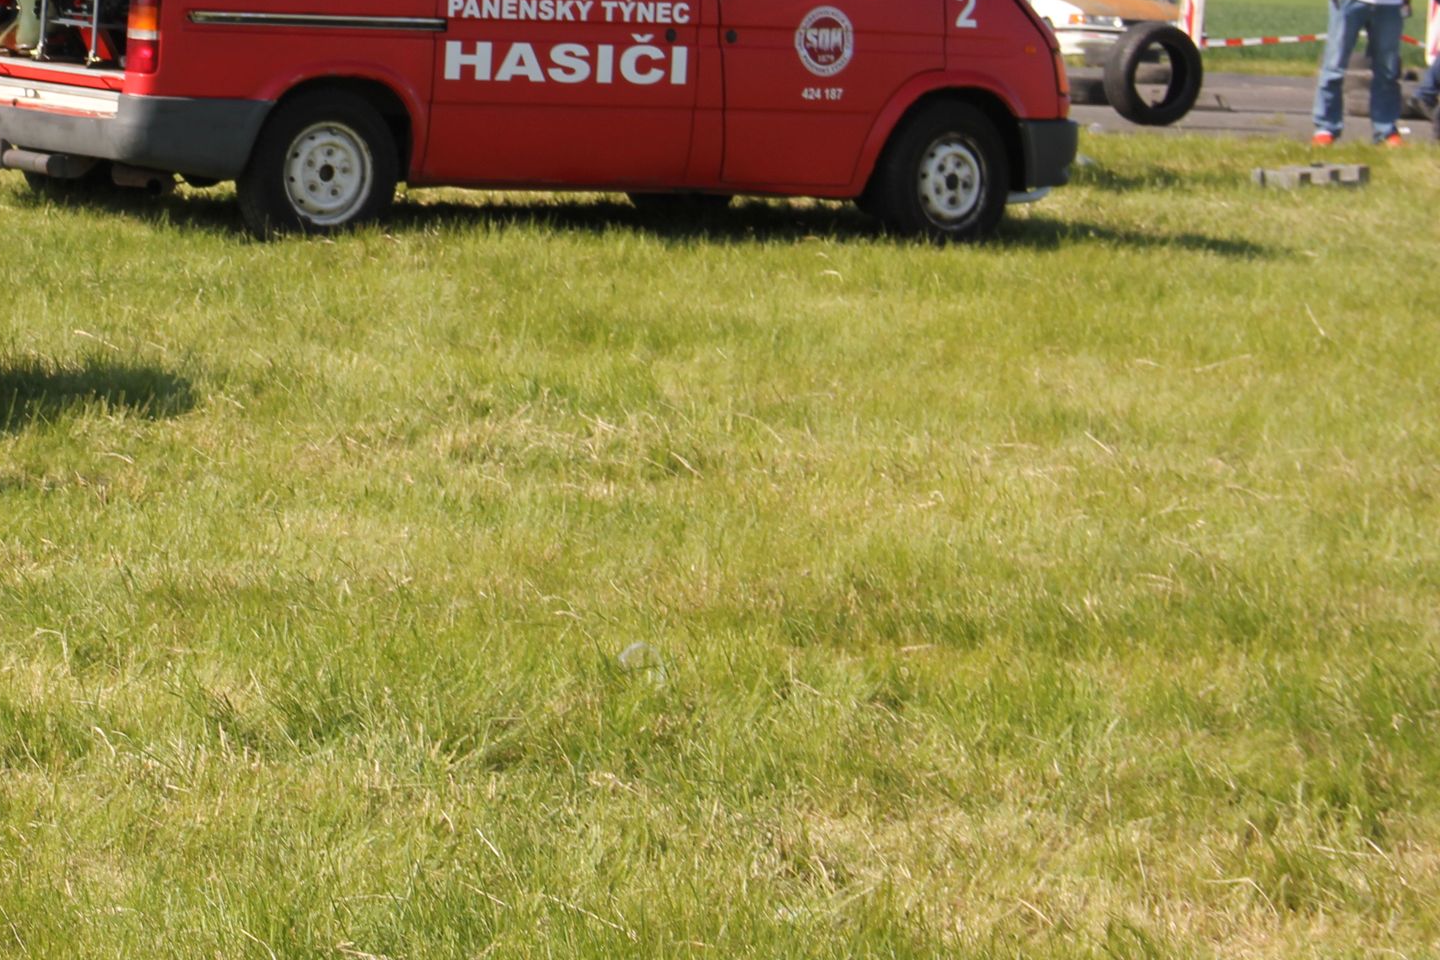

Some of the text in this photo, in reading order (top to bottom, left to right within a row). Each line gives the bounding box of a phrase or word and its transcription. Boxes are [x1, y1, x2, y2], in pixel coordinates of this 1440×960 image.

[444, 33, 688, 85] HASIČI
[802, 88, 843, 100] 424 187
